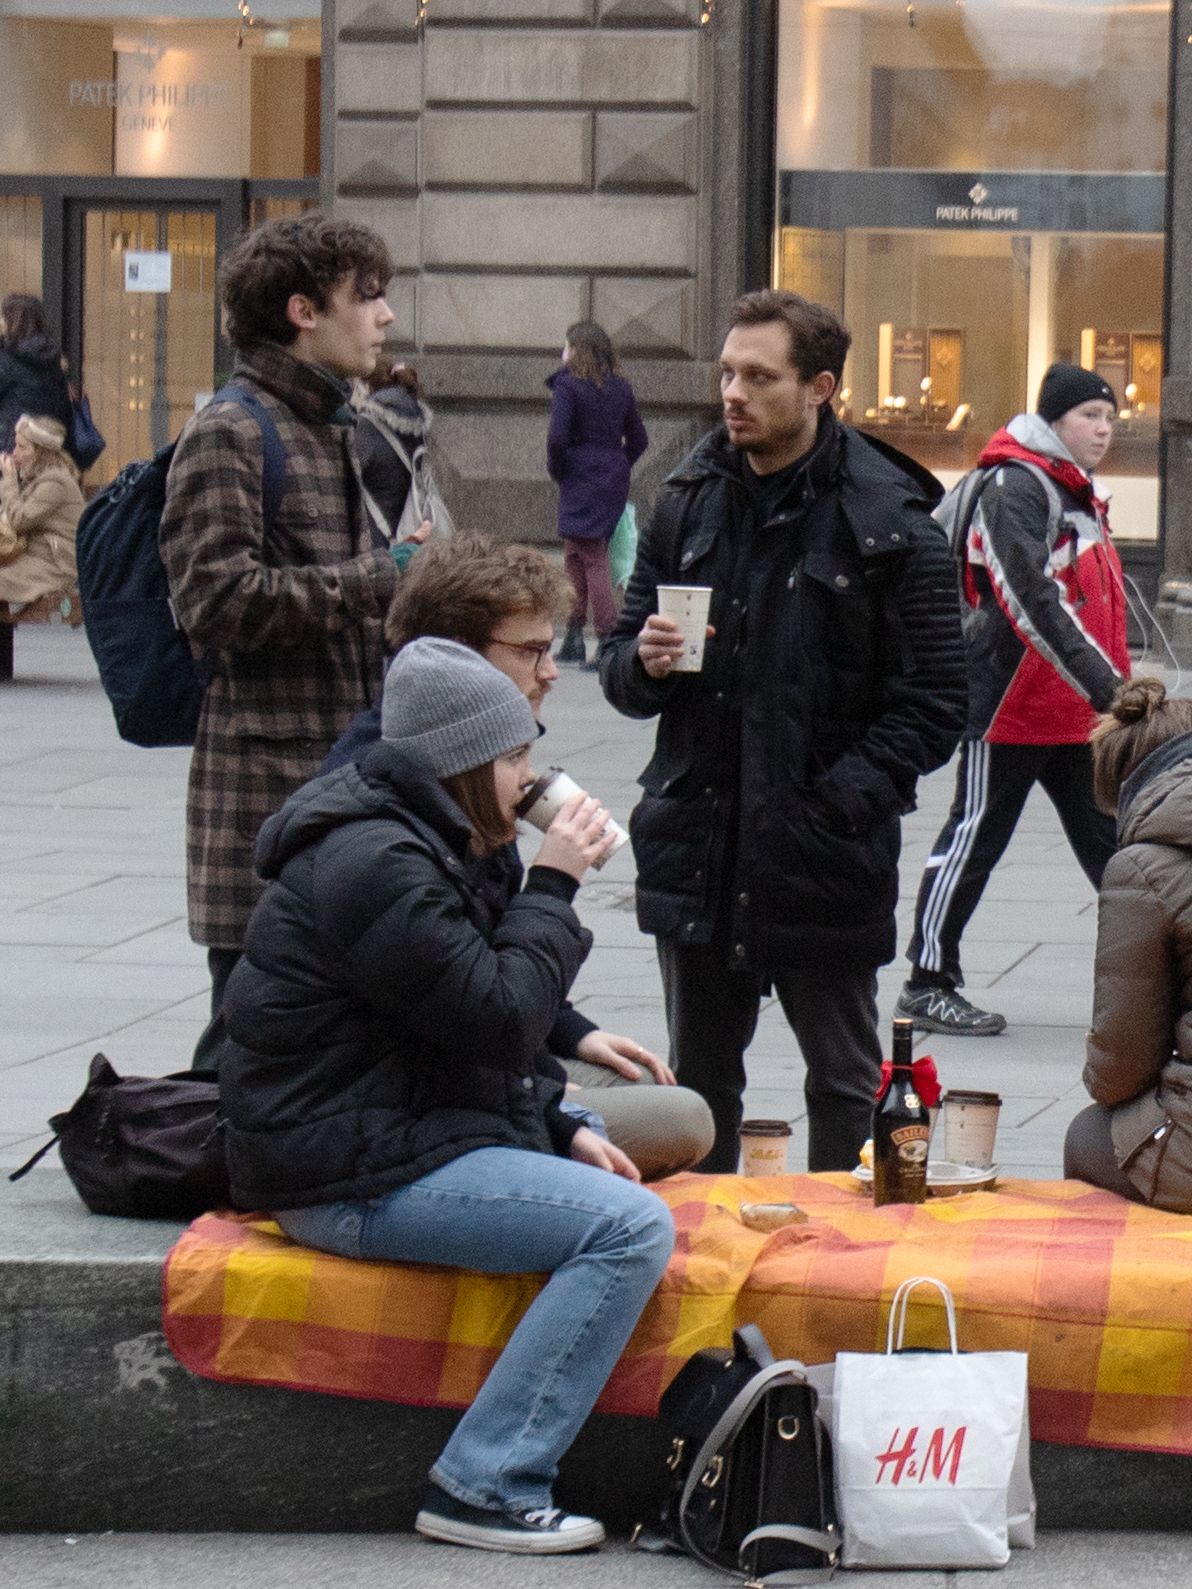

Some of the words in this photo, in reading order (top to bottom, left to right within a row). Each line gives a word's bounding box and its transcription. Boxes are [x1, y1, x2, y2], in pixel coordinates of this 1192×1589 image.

[67, 79, 132, 107] PATEK
[936, 206, 969, 221] PATEK
[970, 207, 1019, 222] PHILIPPE
[874, 1426, 967, 1487] H&M
